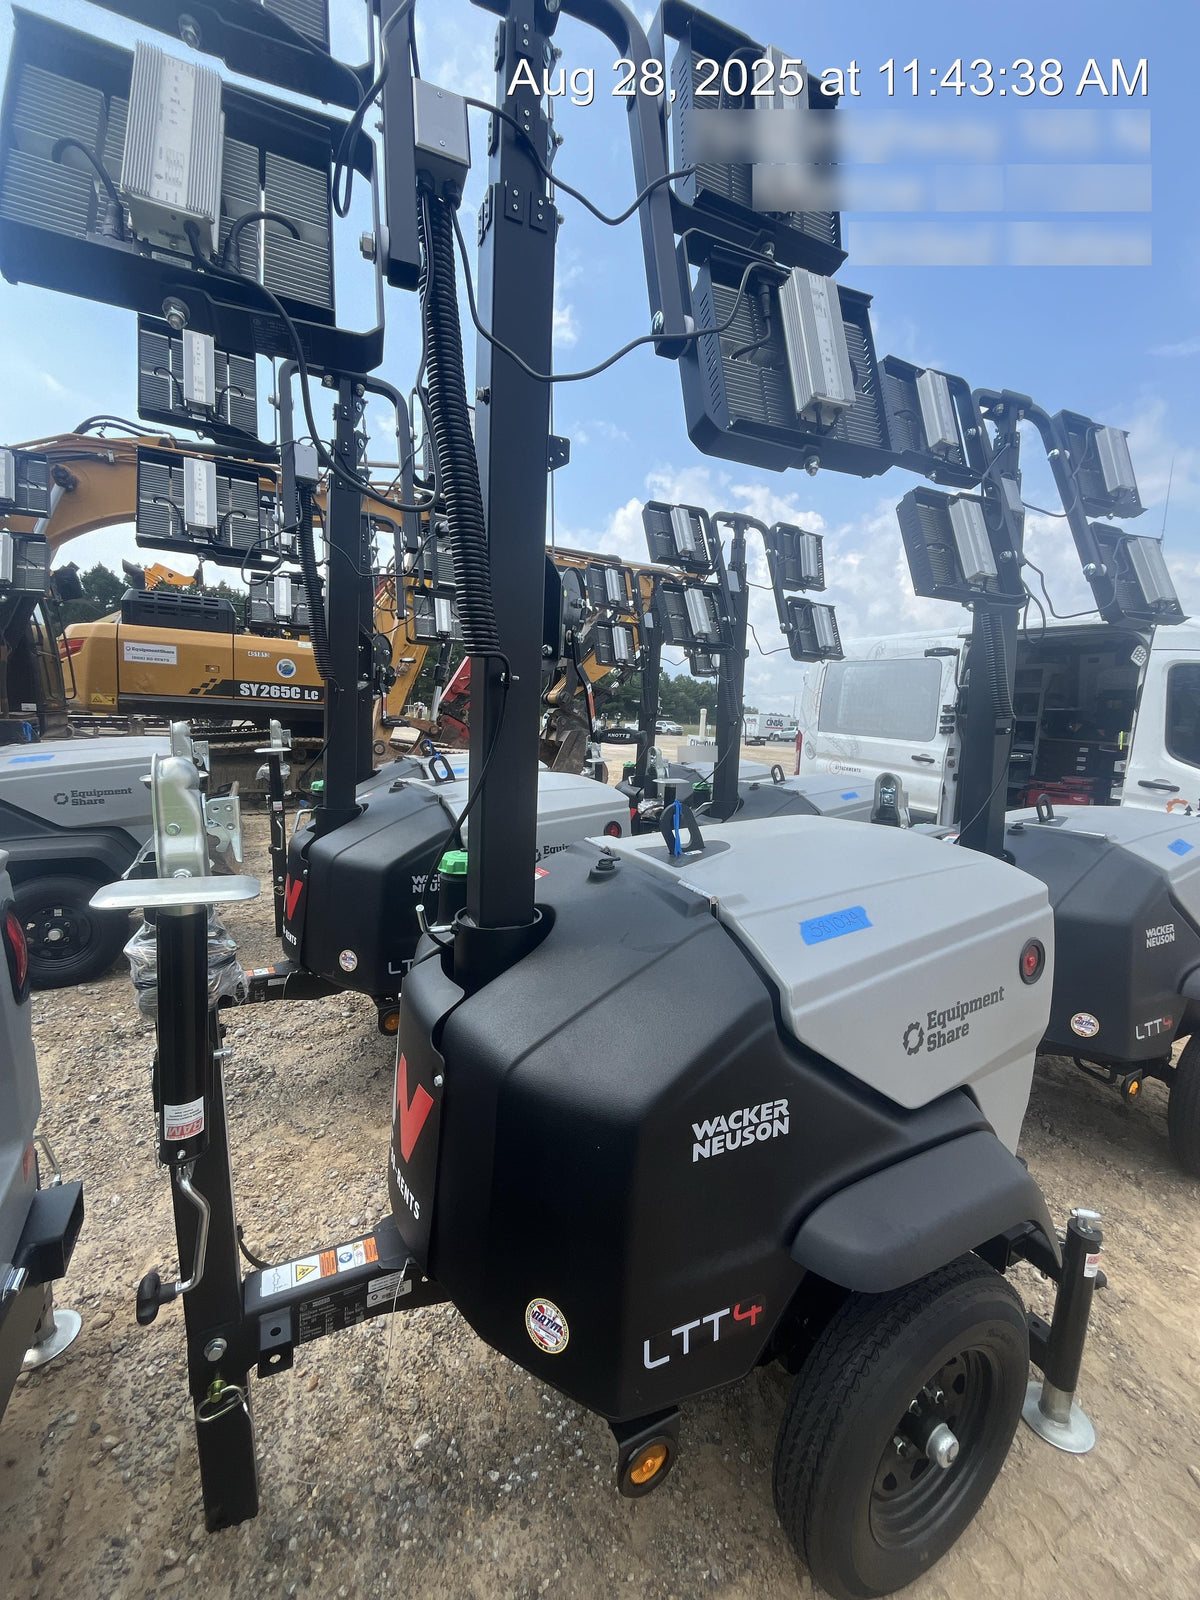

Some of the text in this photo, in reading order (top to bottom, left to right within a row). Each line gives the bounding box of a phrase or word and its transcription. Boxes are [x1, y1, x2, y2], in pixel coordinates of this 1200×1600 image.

[239, 683, 319, 700] SY265C LC
[70, 787, 132, 798] Equipment
[71, 798, 105, 806] Share
[1145, 923, 1175, 939] WACKER
[1146, 932, 1175, 949] NEUSON
[388, 958, 414, 975] LT
[926, 986, 1005, 1030] Equipment
[926, 1022, 970, 1052] Share
[1135, 1017, 1173, 1040] LTT4
[691, 1098, 790, 1141] WACKER
[692, 1116, 790, 1163] NEUSON
[643, 1303, 763, 1370] LTT4
